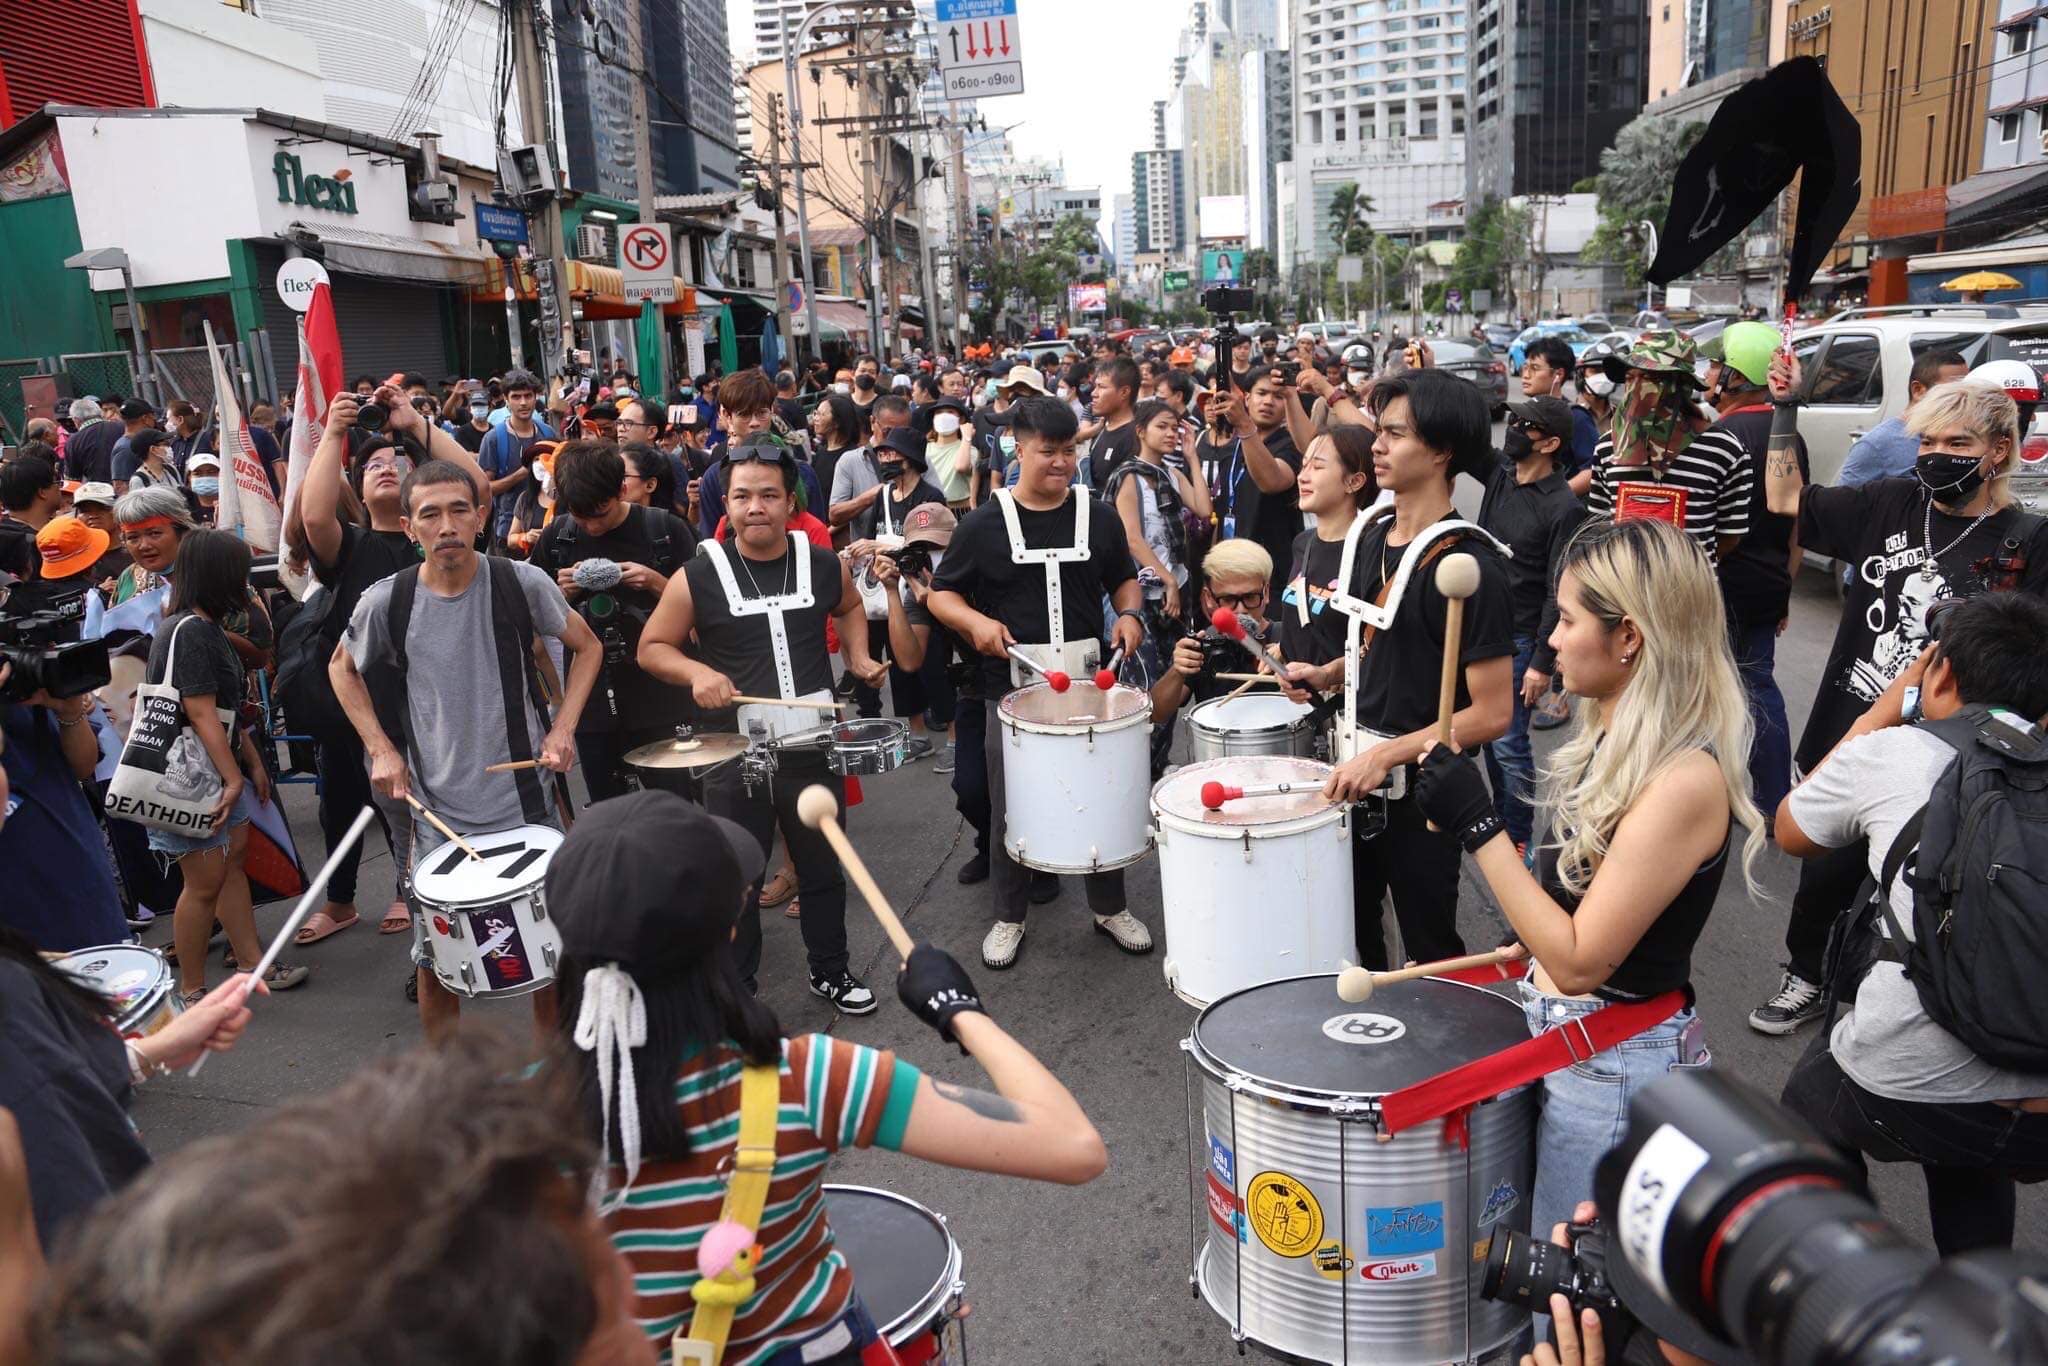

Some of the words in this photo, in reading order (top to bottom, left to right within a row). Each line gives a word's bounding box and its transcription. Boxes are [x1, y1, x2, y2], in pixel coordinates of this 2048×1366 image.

[272, 151, 359, 214] flexi
[283, 278, 315, 293] flex
[2004, 378, 2025, 388] 628
[154, 699, 177, 713] GOD
[150, 711, 175, 725] KING
[139, 721, 158, 732] NLY
[133, 732, 164, 747] UMAN
